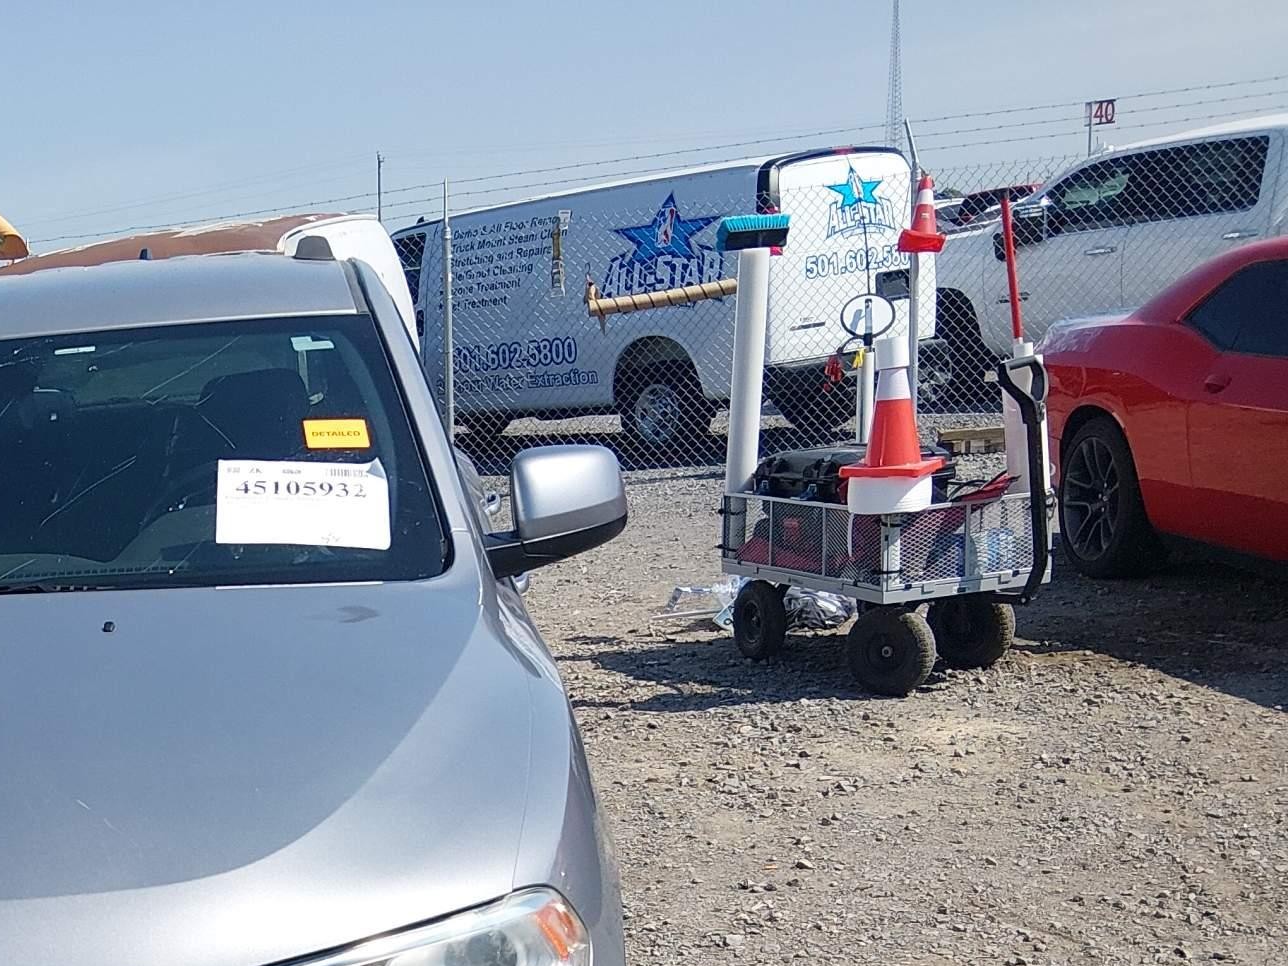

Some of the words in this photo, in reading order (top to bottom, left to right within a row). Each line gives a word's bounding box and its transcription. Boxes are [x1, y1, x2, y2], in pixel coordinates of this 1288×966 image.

[1093, 101, 1116, 123] 40
[825, 196, 897, 240] ALL-STAR
[453, 229, 479, 240] Demo
[488, 223, 502, 234] All
[503, 221, 530, 233] Floor
[452, 240, 475, 254] Truck
[477, 236, 507, 250] Mount
[508, 232, 538, 246] Steam
[540, 229, 568, 241] Cln
[496, 250, 514, 261] and
[515, 246, 553, 260] Repairs
[805, 244, 910, 279] 501.602.580
[492, 263, 534, 276] Cleaning
[601, 244, 724, 299] ALL-STAR
[450, 285, 474, 297] zone
[476, 279, 521, 293] Treatment
[463, 295, 509, 310] Treatment
[484, 372, 525, 391] Water
[527, 367, 600, 389] Extraction
[236, 480, 368, 499] 45105932
